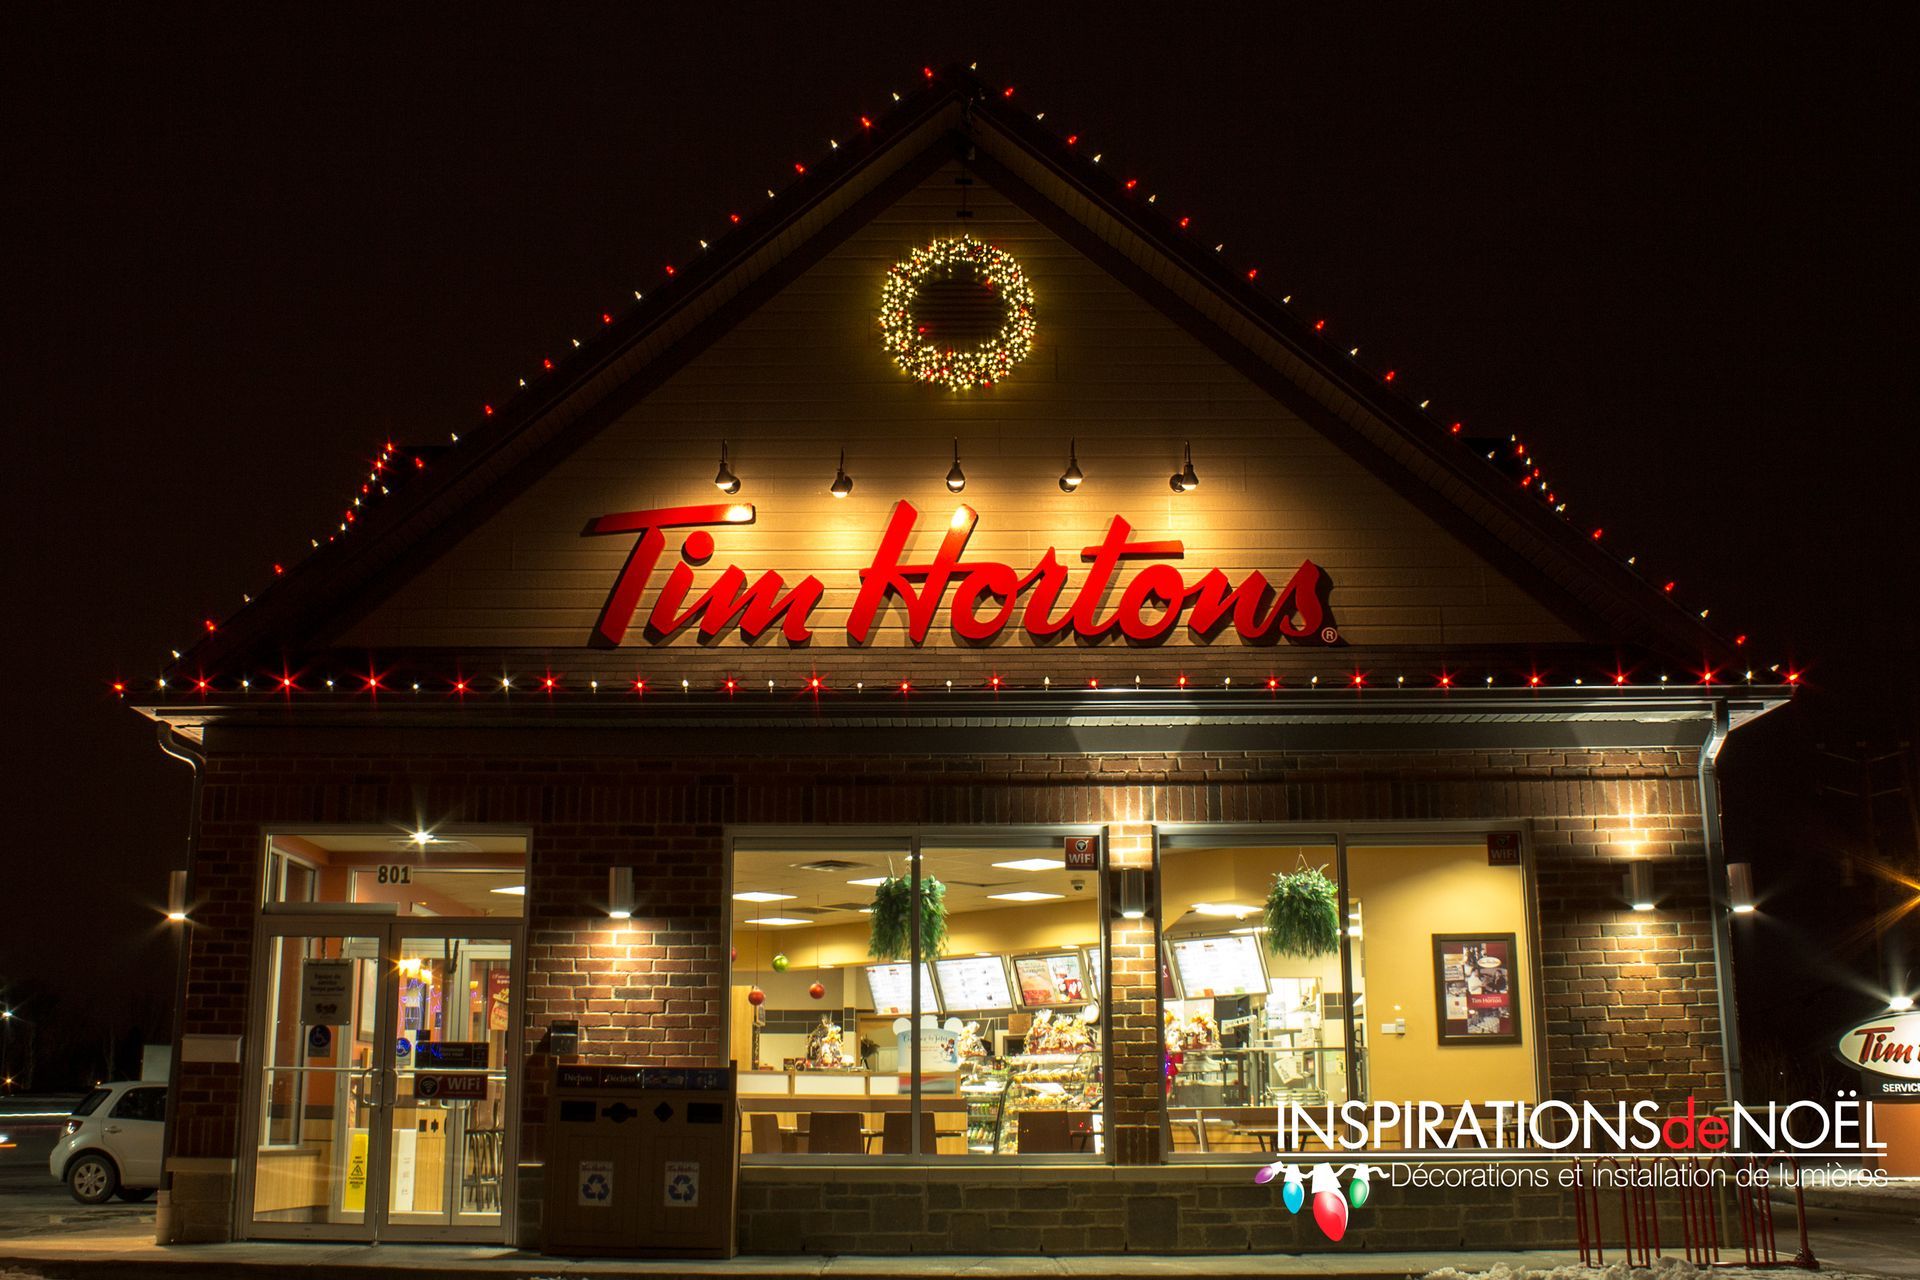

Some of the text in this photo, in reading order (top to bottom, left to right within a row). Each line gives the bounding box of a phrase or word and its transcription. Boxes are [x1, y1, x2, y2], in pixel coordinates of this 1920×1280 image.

[582, 499, 1324, 646] Tim Hortons
[1068, 853, 1095, 864] WiFi
[378, 865, 411, 884] 801
[1854, 1026, 1914, 1065] Tim
[447, 1077, 481, 1091] WiFi
